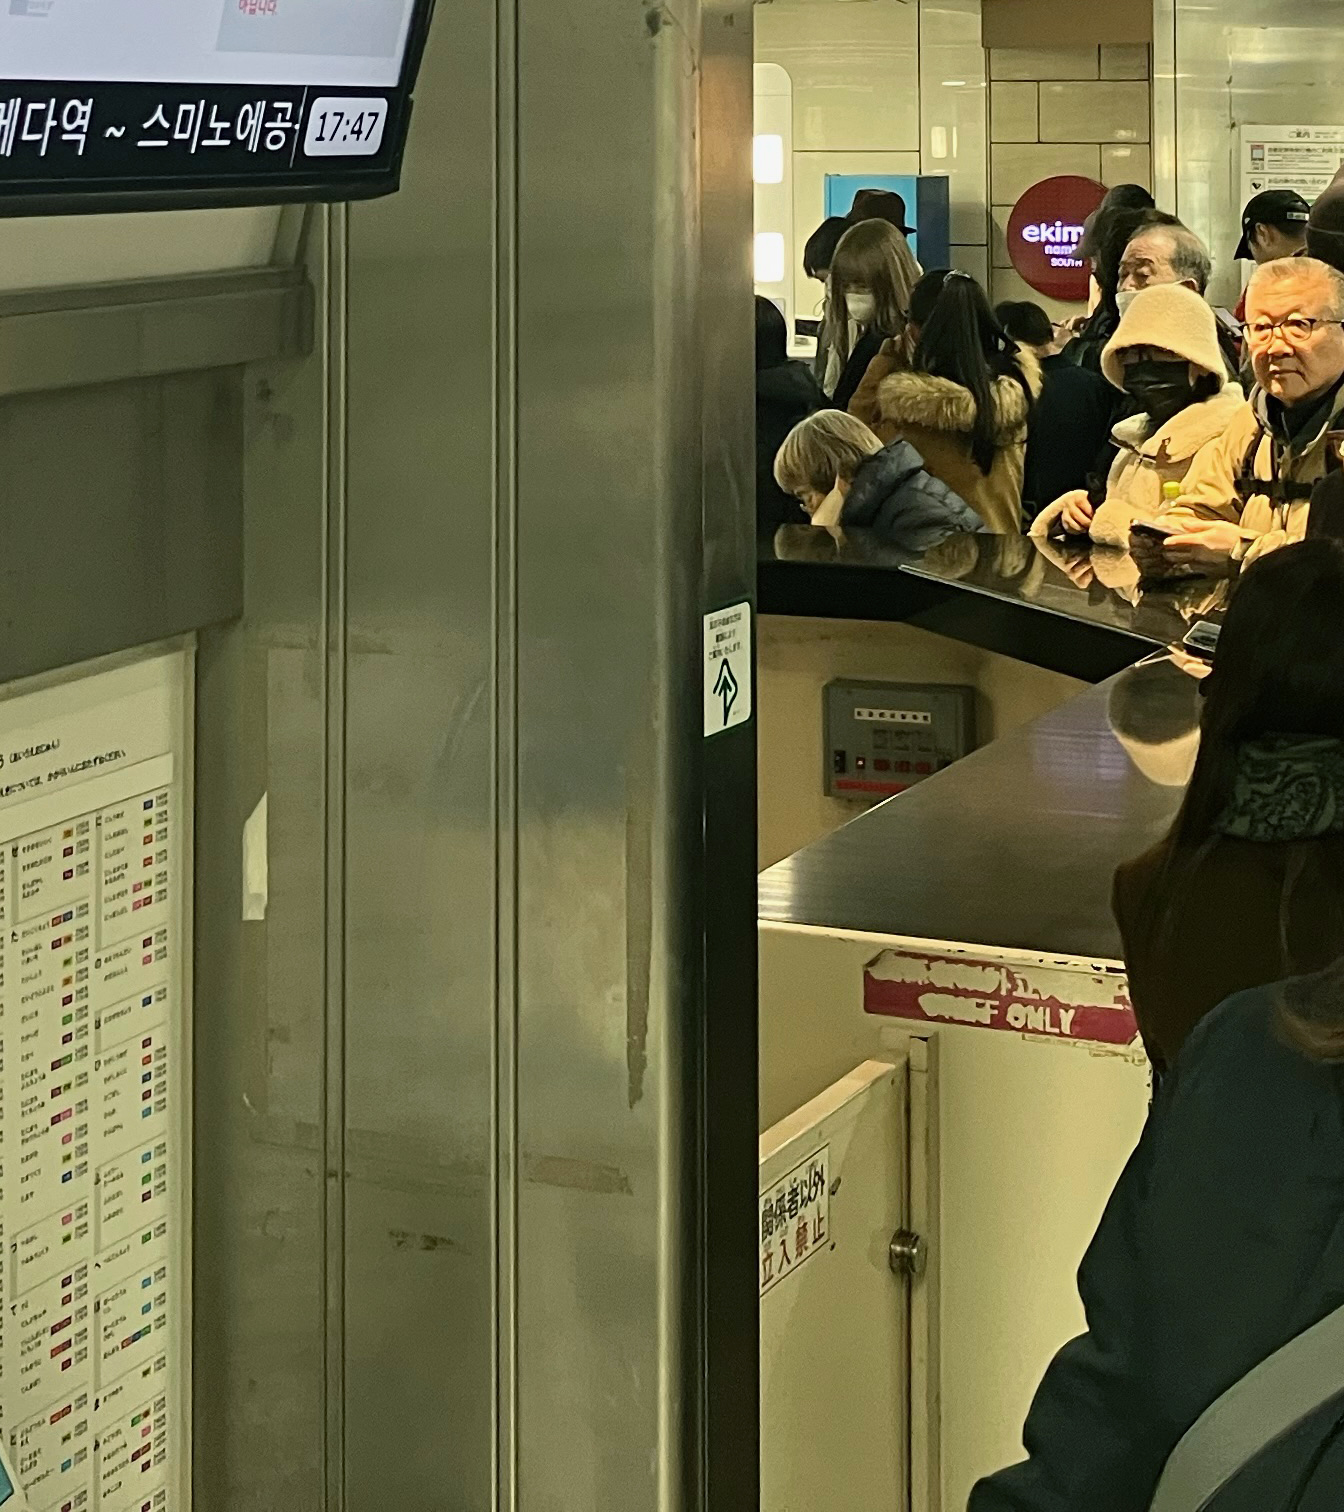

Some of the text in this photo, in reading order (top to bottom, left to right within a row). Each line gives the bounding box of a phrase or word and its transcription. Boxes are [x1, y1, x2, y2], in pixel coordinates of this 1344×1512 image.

[137, 98, 300, 155] 스미노에공
[315, 111, 380, 144] 17:47
[1022, 220, 1084, 243] ekim
[1044, 243, 1078, 255] nam
[1006, 1003, 1076, 1035] ONLY
[762, 1205, 825, 1287] 立入禁止
